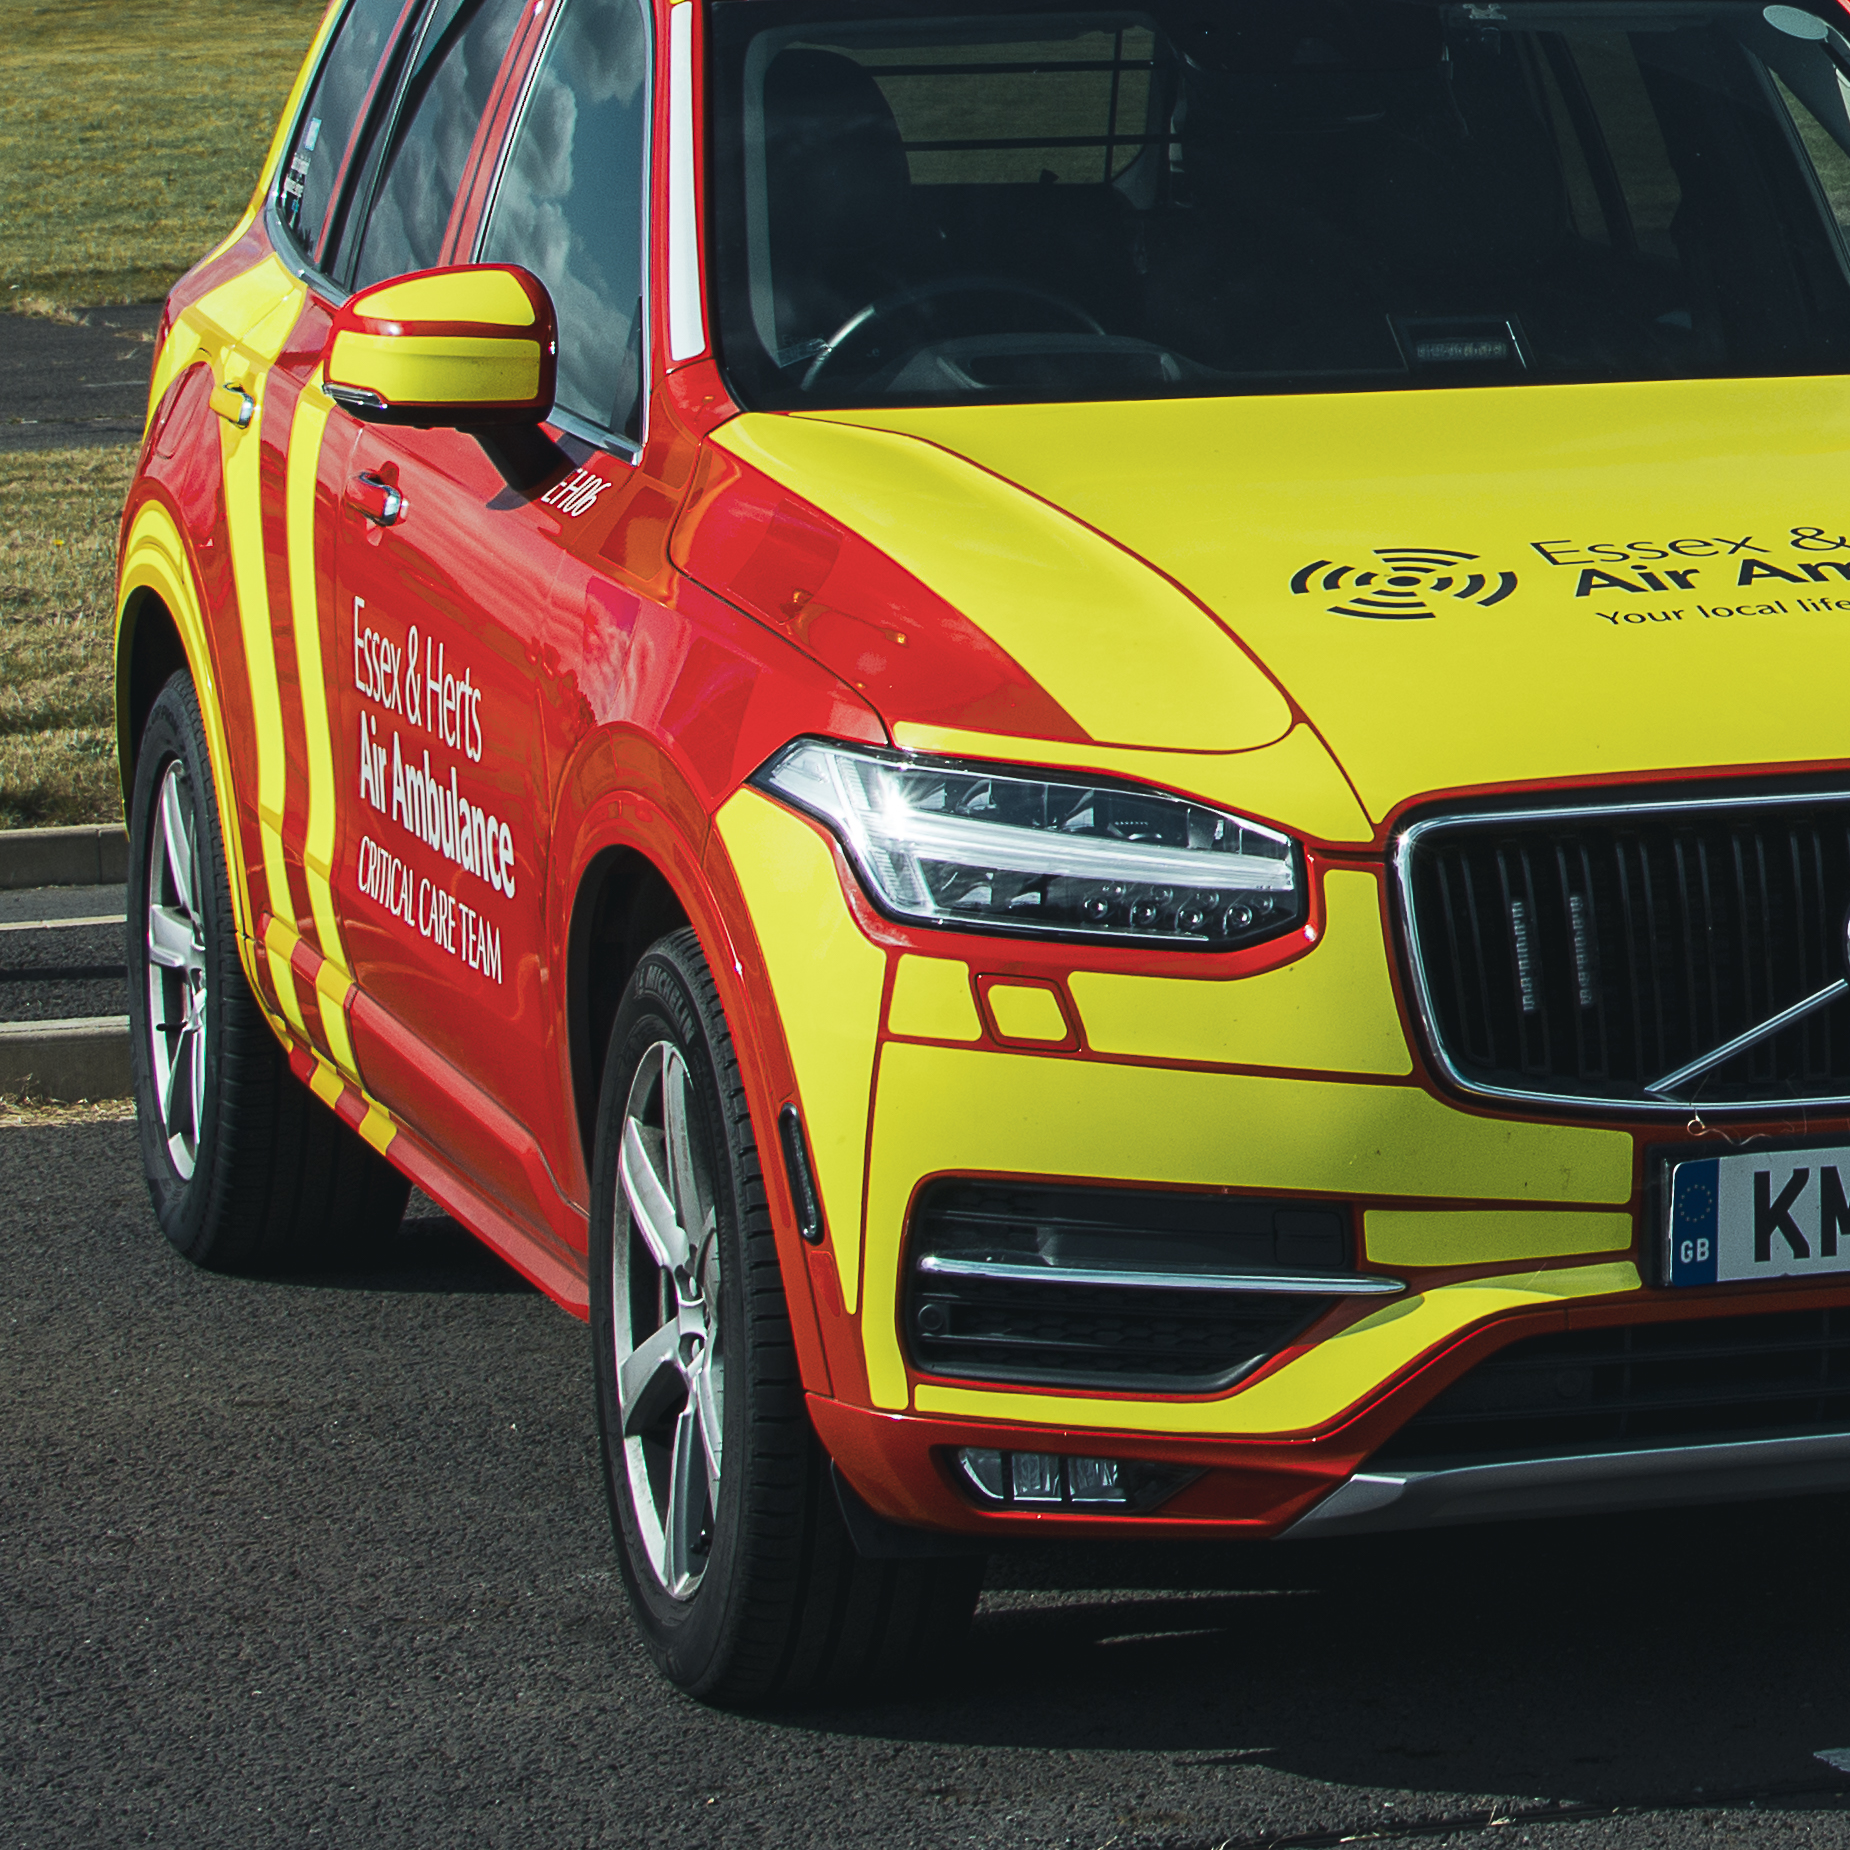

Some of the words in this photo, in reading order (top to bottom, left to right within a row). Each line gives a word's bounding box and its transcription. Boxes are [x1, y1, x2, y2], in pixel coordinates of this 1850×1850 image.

[541, 467, 612, 517] EH06
[1529, 535, 1773, 566] Essex
[1575, 564, 1701, 598] Air
[1595, 607, 1686, 626] Your
[1696, 600, 1790, 620] local
[353, 595, 403, 715] Essex
[405, 624, 423, 727] &
[426, 635, 483, 763] Herts
[359, 709, 387, 815] Air
[391, 730, 516, 900] Ambulance
[357, 834, 415, 928] CRITICAL
[418, 877, 457, 955] CARE
[458, 901, 503, 985] TEAM
[645, 963, 697, 1046] MICHELIN
[1680, 1238, 1710, 1263] GB
